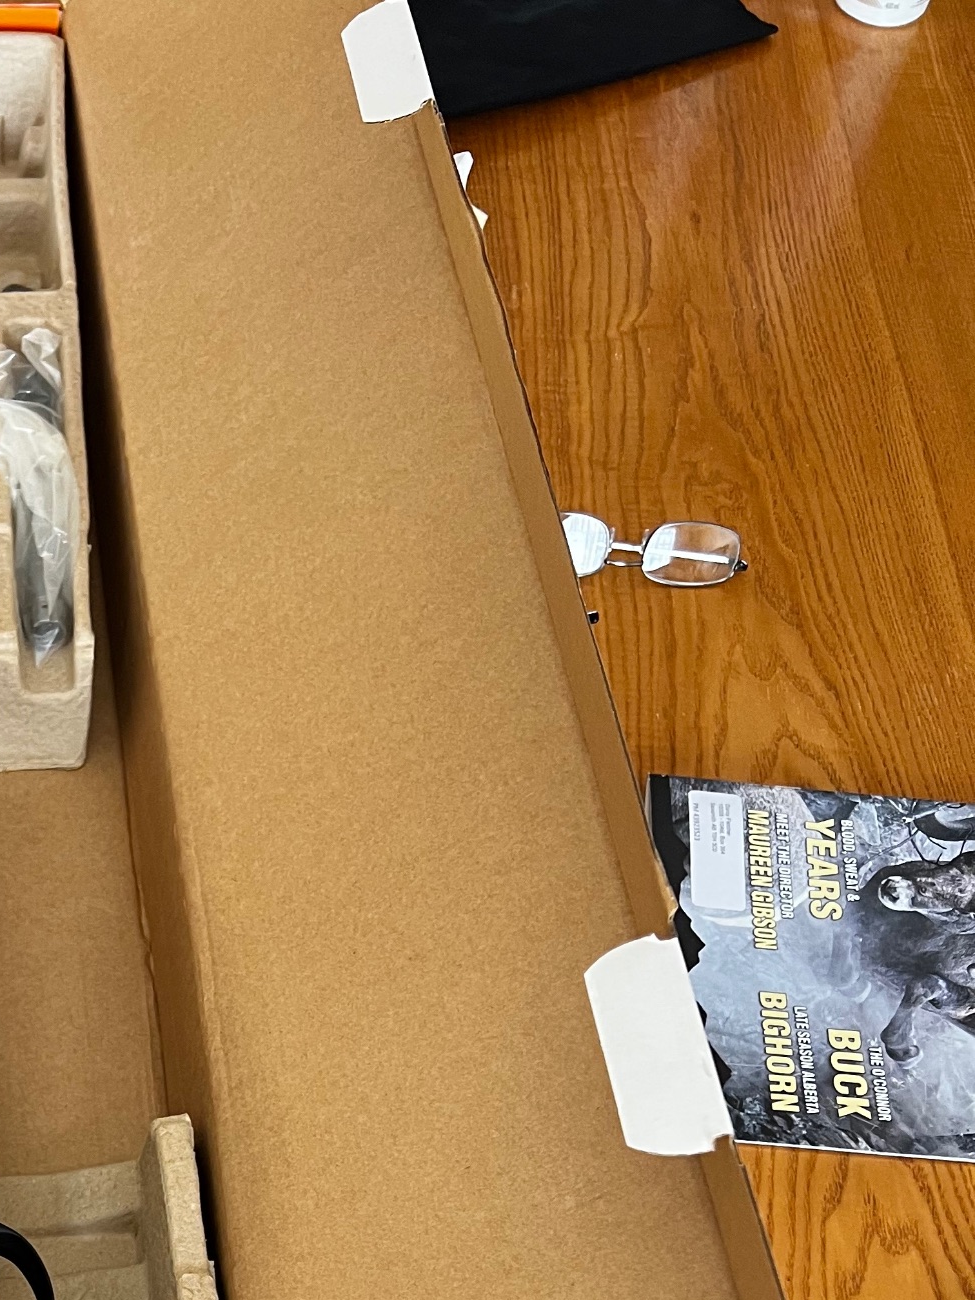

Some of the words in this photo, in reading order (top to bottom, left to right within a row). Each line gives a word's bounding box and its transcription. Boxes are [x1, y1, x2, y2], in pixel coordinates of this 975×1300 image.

[747, 810, 773, 888] MAUREEN
[776, 813, 789, 843] MEET
[777, 845, 790, 866] THE
[805, 818, 843, 921] YEARS
[843, 857, 860, 891] SWEAT
[779, 867, 794, 919] DIRECTOR
[847, 894, 860, 902] &
[751, 890, 777, 950] GIBSON
[793, 1006, 810, 1030] LATE
[758, 991, 800, 1113] BIGHORN
[796, 1031, 815, 1070] SEASON
[868, 1046, 884, 1067] THE
[801, 1070, 819, 1114] ALBERTA
[827, 1028, 873, 1120] BUCK
[871, 1068, 892, 1122] O'CONNOR
